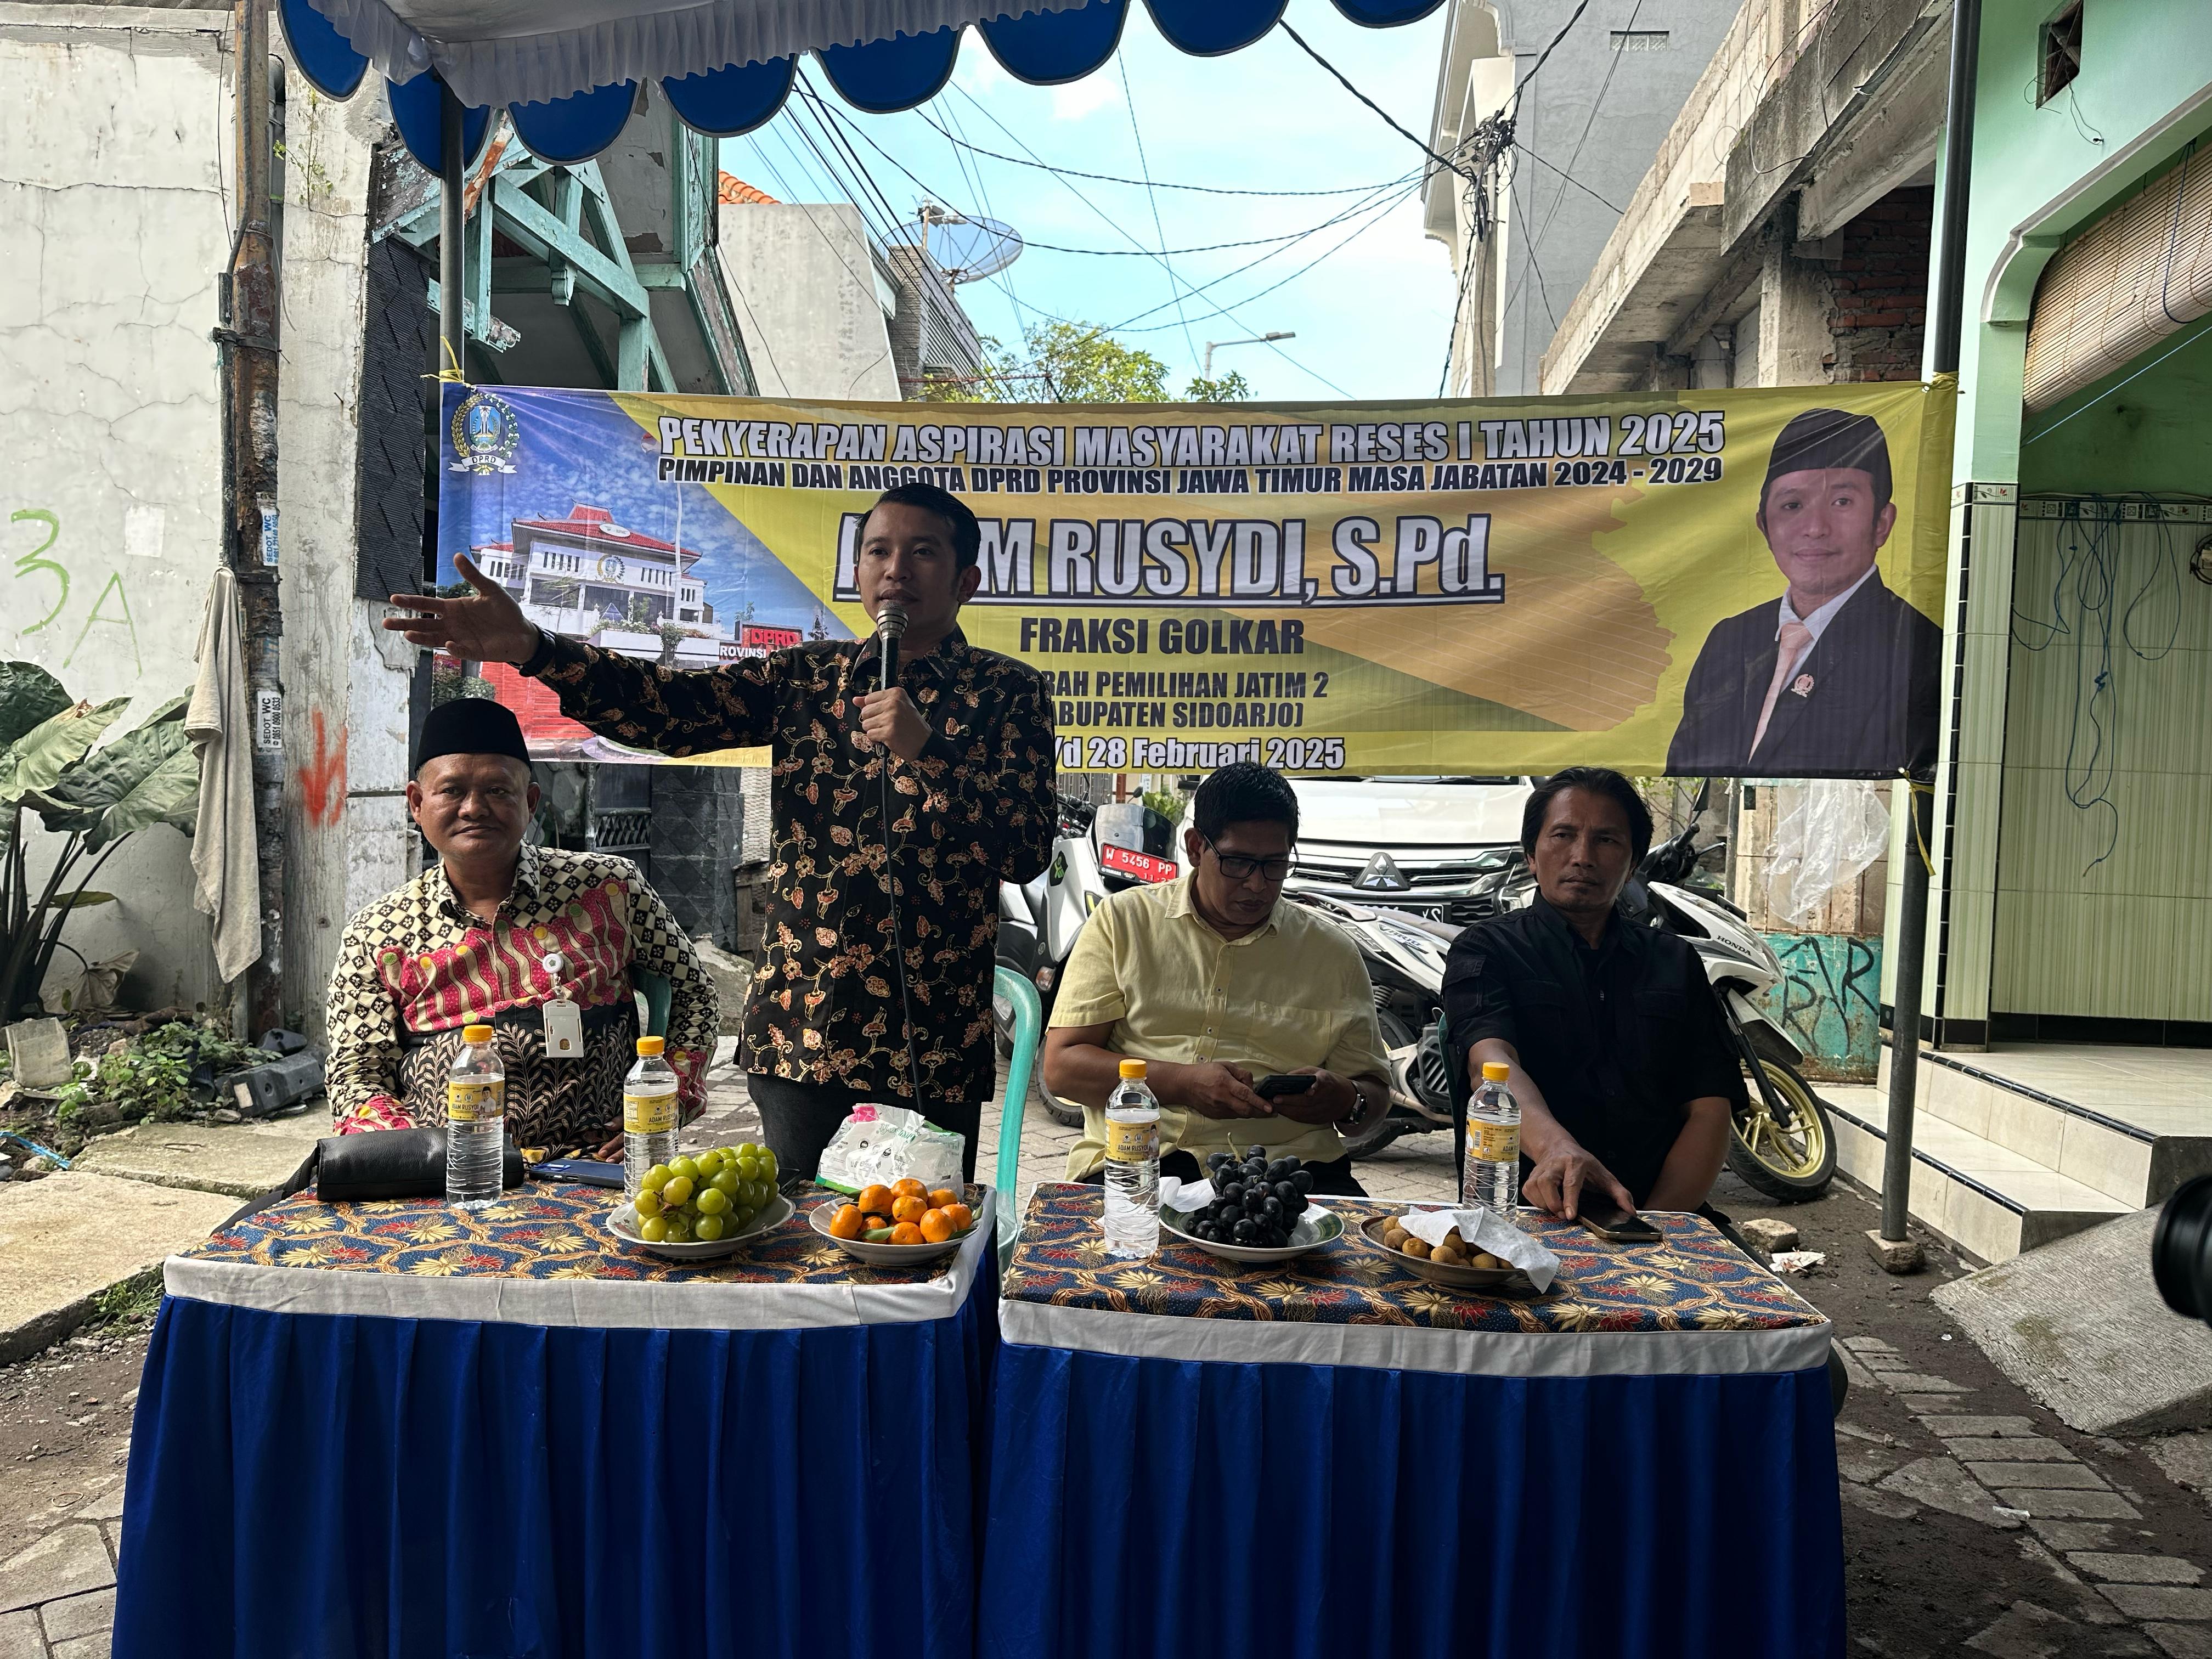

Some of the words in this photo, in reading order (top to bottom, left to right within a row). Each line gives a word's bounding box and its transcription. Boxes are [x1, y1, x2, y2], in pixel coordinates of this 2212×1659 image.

[659, 415, 887, 462] PENYERAPAN
[892, 424, 1066, 466] ASPIRASI
[1073, 424, 1323, 467] MASYARAKAT
[1329, 421, 1449, 464] RESES
[1457, 421, 1472, 460] I
[1479, 416, 1611, 460] TAHUN
[1617, 410, 1726, 457] 2025
[472, 455, 496, 464] DPRD
[659, 458, 786, 487] PIMPINAN
[792, 462, 842, 489] DAN
[849, 465, 967, 492] ANGGOTA
[971, 467, 1043, 493] DPRD
[1048, 469, 1170, 493] PROVINSI
[1177, 469, 1250, 493] JAWA
[1254, 467, 1342, 493] TIMUR
[1348, 464, 1425, 492] MASA
[1430, 462, 1548, 491] JABATAN
[1554, 460, 1628, 486] 2024
[1648, 457, 1723, 484] 2029
[264, 515, 272, 531] WC
[1048, 518, 1318, 606] RUSYDI,
[1331, 514, 1505, 599] S.Pd.
[751, 628, 797, 646] DPRD
[1020, 617, 1148, 654] FRAKSI
[1159, 618, 1304, 654] GOLKAR
[720, 646, 766, 658] ROVINSI
[1041, 671, 1089, 697] RAH
[1096, 672, 1228, 697] PEMILIHAN
[1234, 672, 1306, 698] JATIM
[1313, 672, 1329, 698] 2
[262, 697, 270, 714] WC
[1052, 701, 1165, 727] BUPATEN
[1087, 736, 1127, 769] 28
[1132, 737, 1261, 769] Februari
[1266, 736, 1345, 770] 2025
[1105, 848, 1115, 860] W
[1122, 853, 1150, 870] 5456
[1158, 862, 1172, 874] PP
[1716, 935, 1752, 957] HONDA
